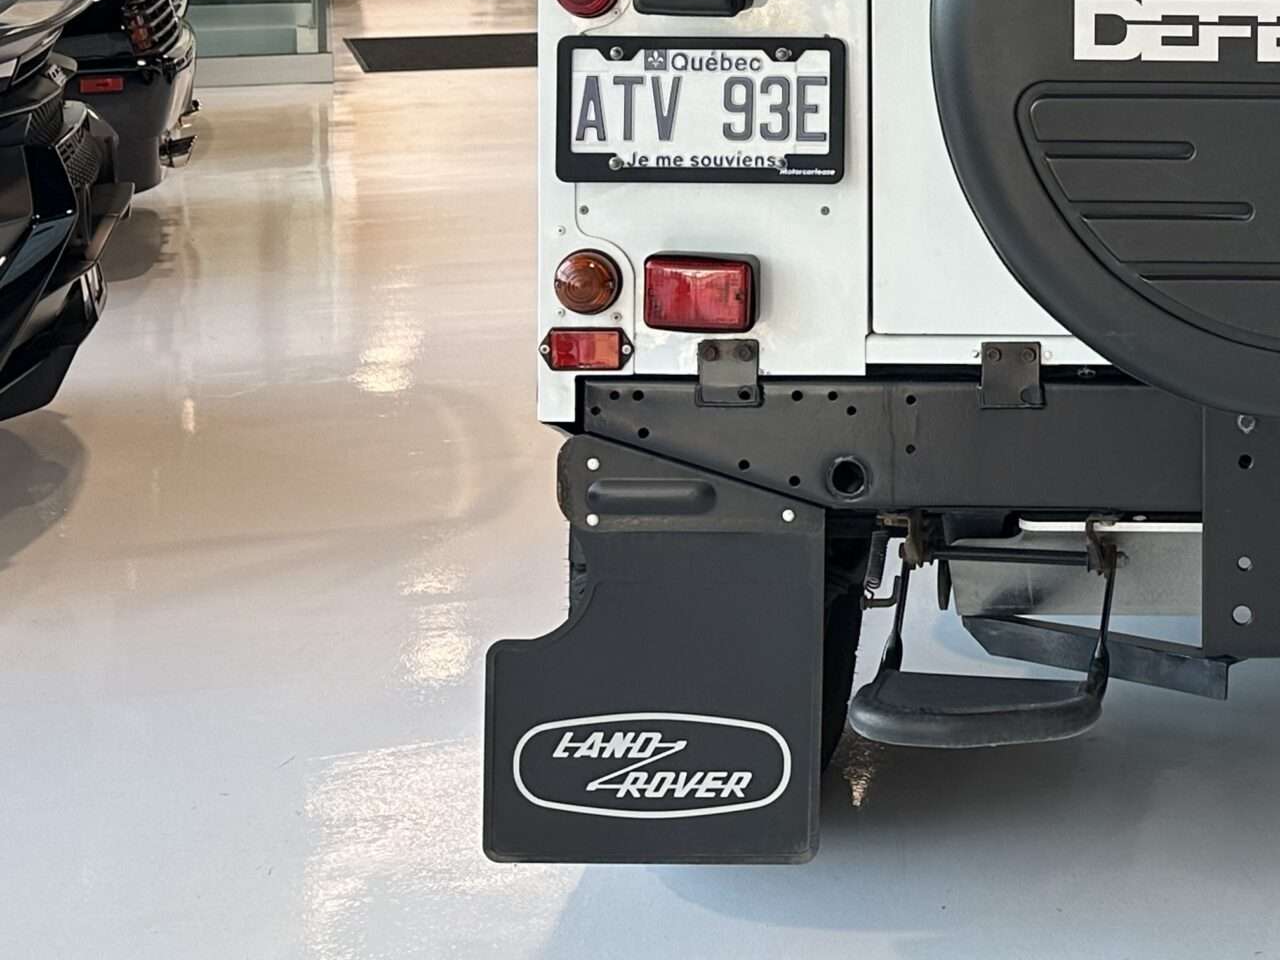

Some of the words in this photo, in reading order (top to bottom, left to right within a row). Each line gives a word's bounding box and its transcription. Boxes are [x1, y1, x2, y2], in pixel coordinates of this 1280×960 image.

[671, 50, 763, 71] Québec
[575, 75, 683, 142] ATV
[722, 75, 828, 142] 93E
[626, 152, 649, 168] Je
[656, 155, 683, 168] me
[692, 151, 777, 168] souviens
[552, 731, 662, 759] LAND
[614, 771, 753, 799] ROVER
